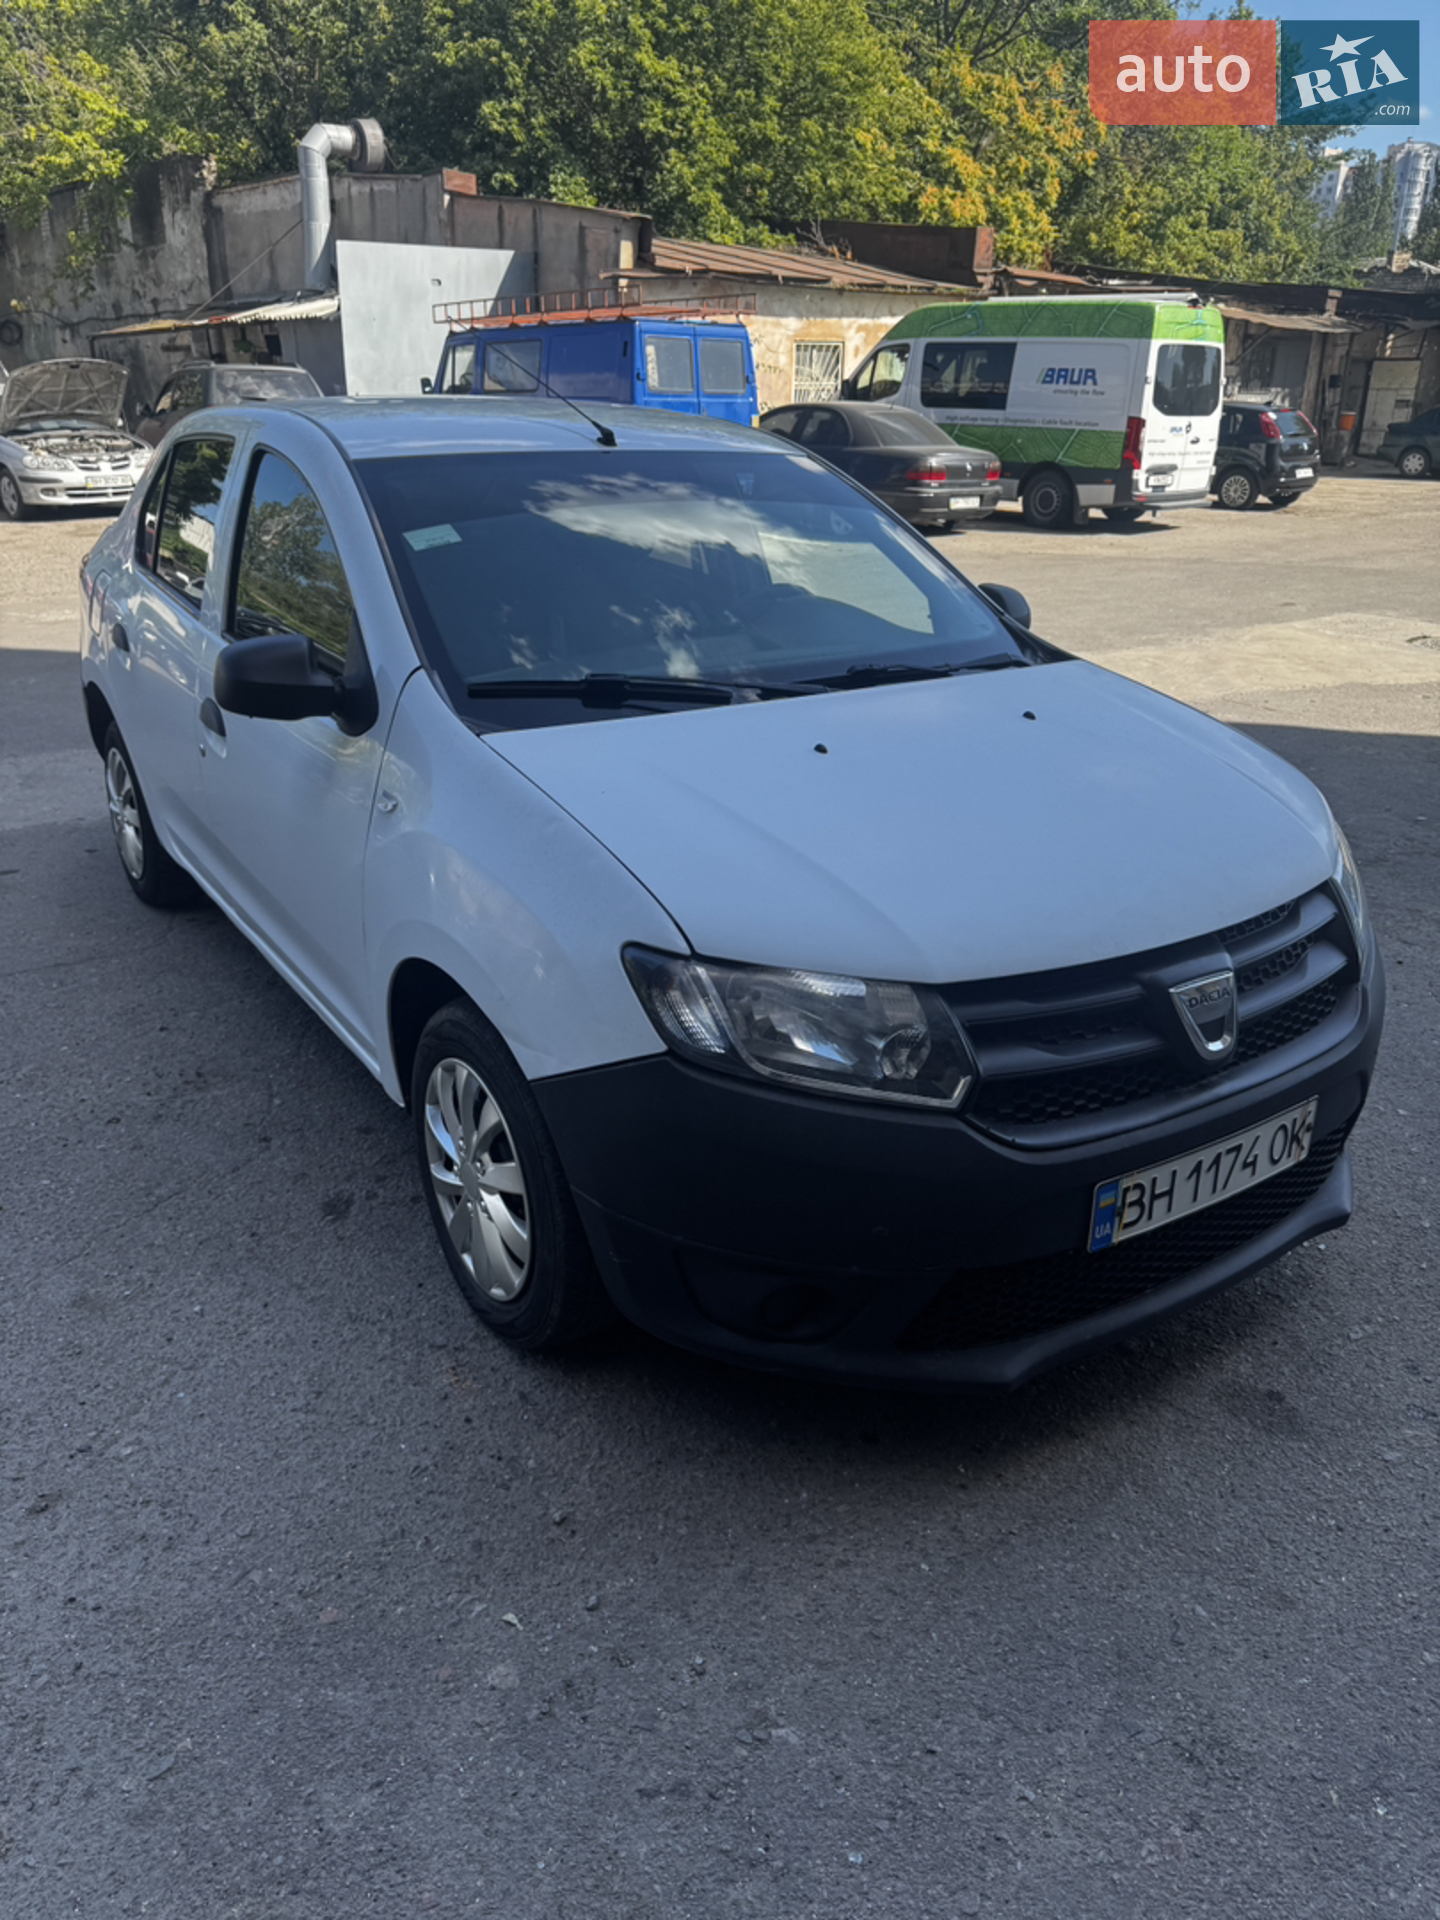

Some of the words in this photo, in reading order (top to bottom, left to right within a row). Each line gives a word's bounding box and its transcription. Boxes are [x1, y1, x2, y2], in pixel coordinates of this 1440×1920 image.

[1041, 367, 1098, 386] BAUR
[1189, 987, 1231, 1008] DACIA
[1119, 1169, 1178, 1231] BH
[1186, 1135, 1261, 1204] 1174
[1269, 1110, 1313, 1167] OK
[1095, 1221, 1112, 1239] UA
